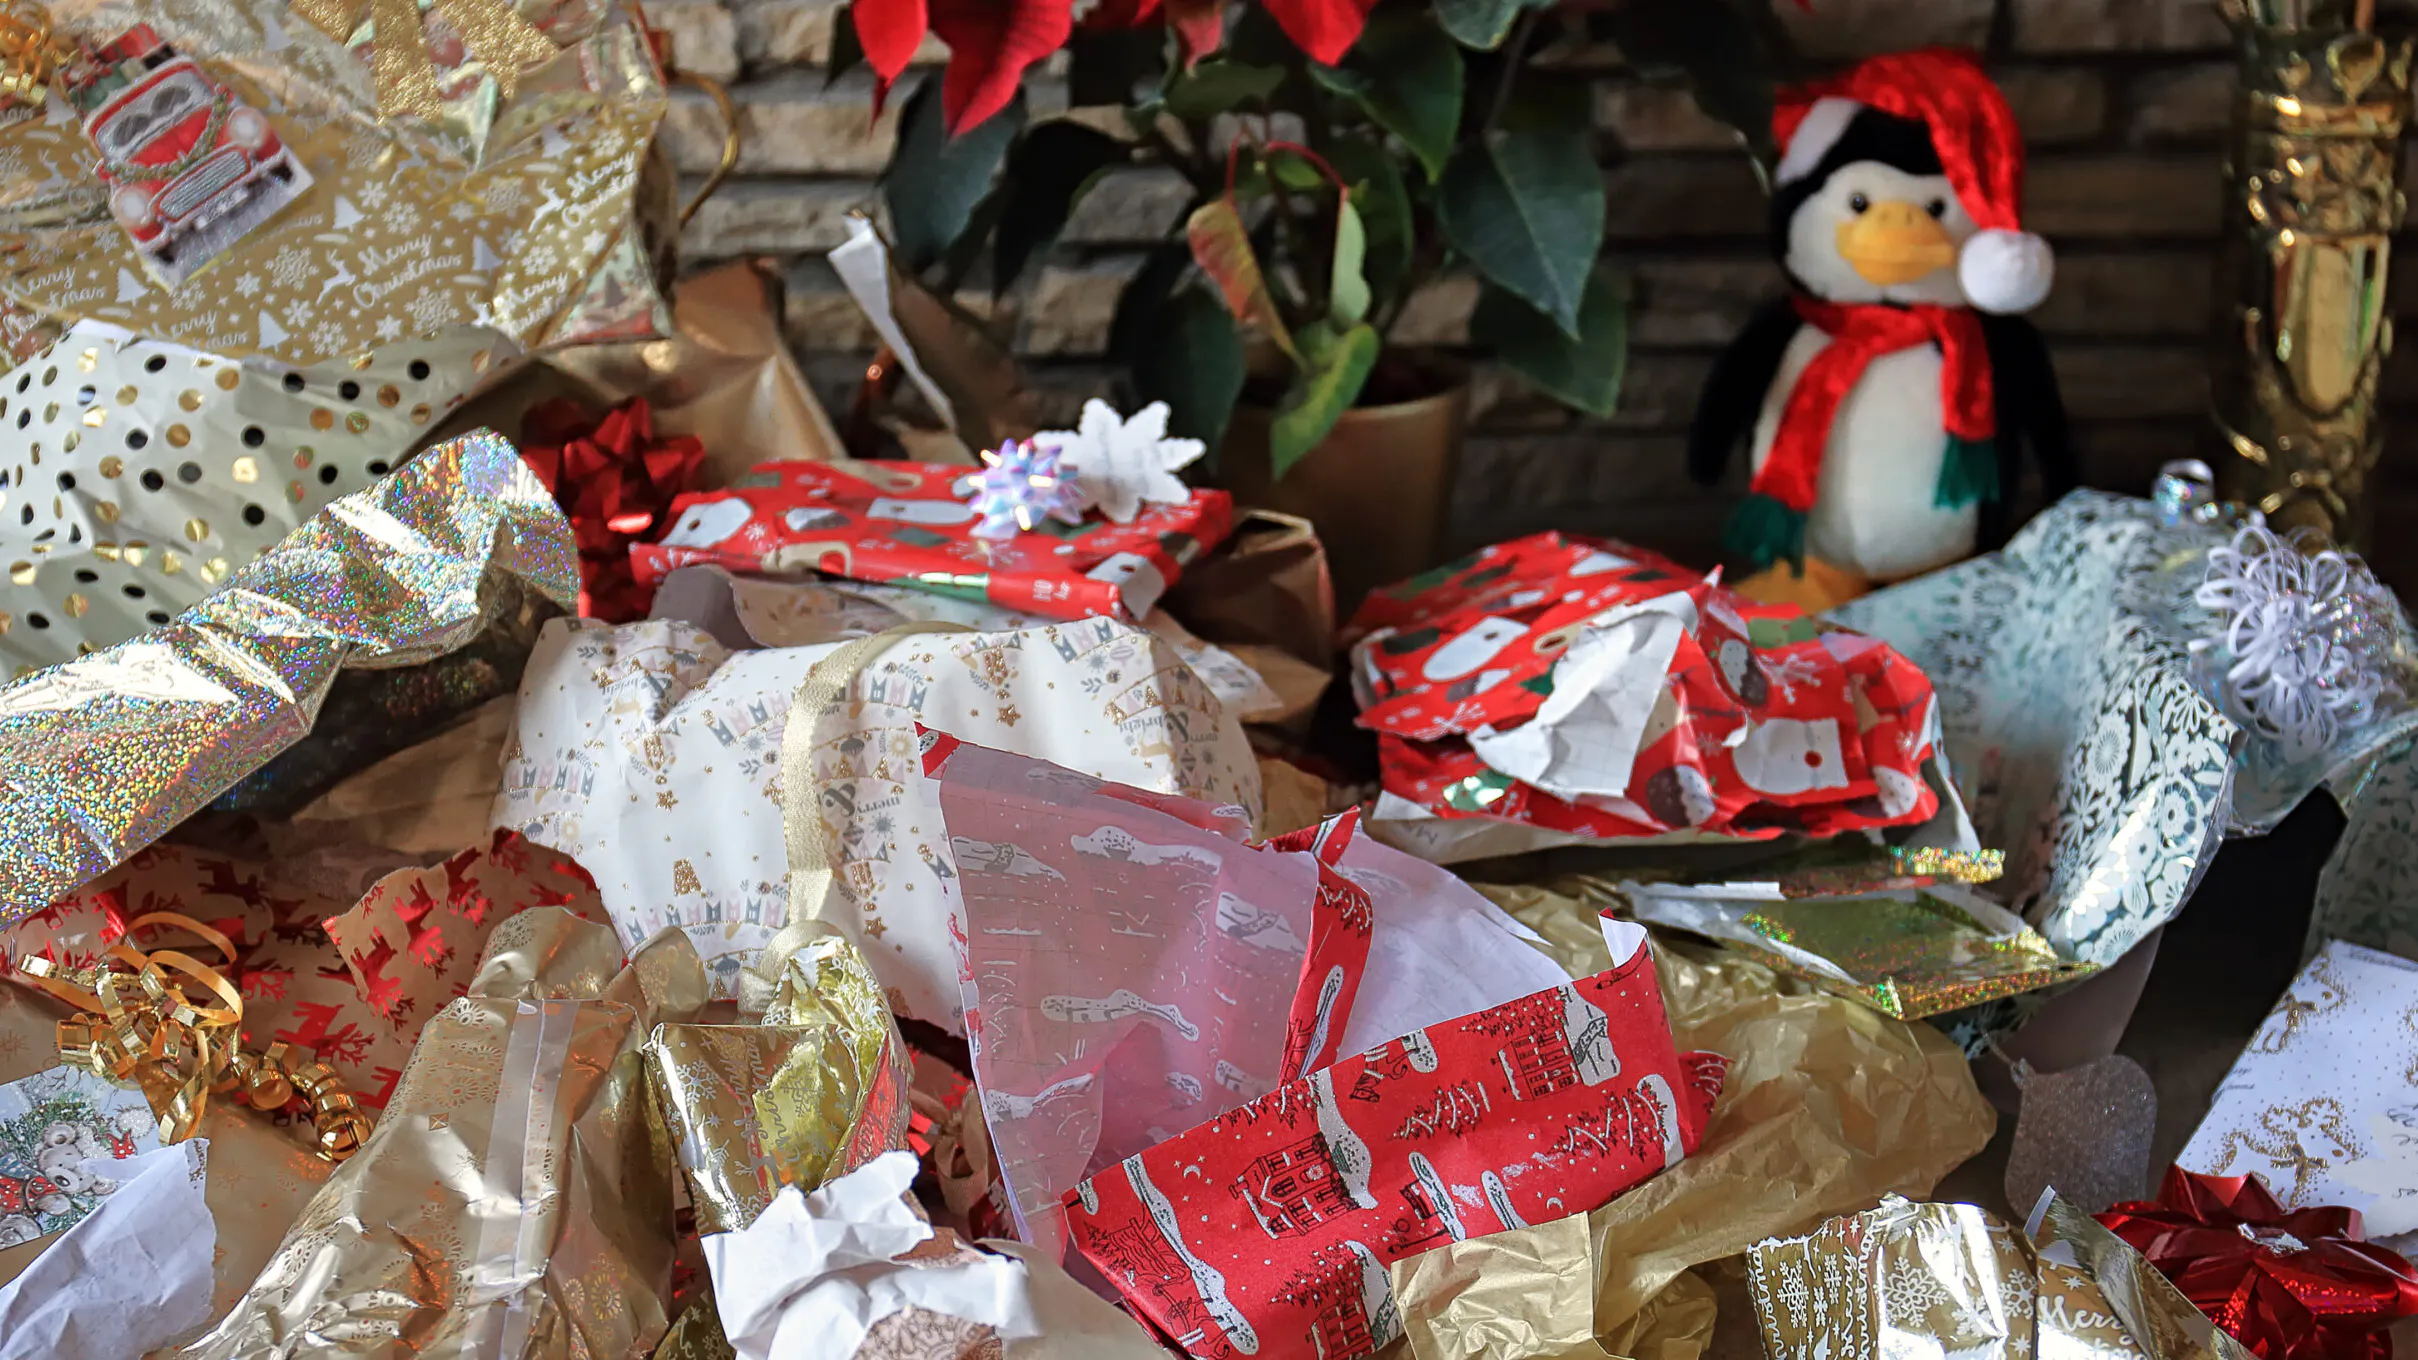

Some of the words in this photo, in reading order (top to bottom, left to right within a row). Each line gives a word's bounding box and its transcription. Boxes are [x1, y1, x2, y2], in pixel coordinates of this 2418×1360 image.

[357, 233, 432, 276] Merry
[353, 254, 462, 309] Christmas
[855, 795, 901, 815] merry
[1752, 1247, 1788, 1360] hristma
[1841, 1245, 1858, 1358] Merry
[2037, 1294, 2135, 1346] Merr
